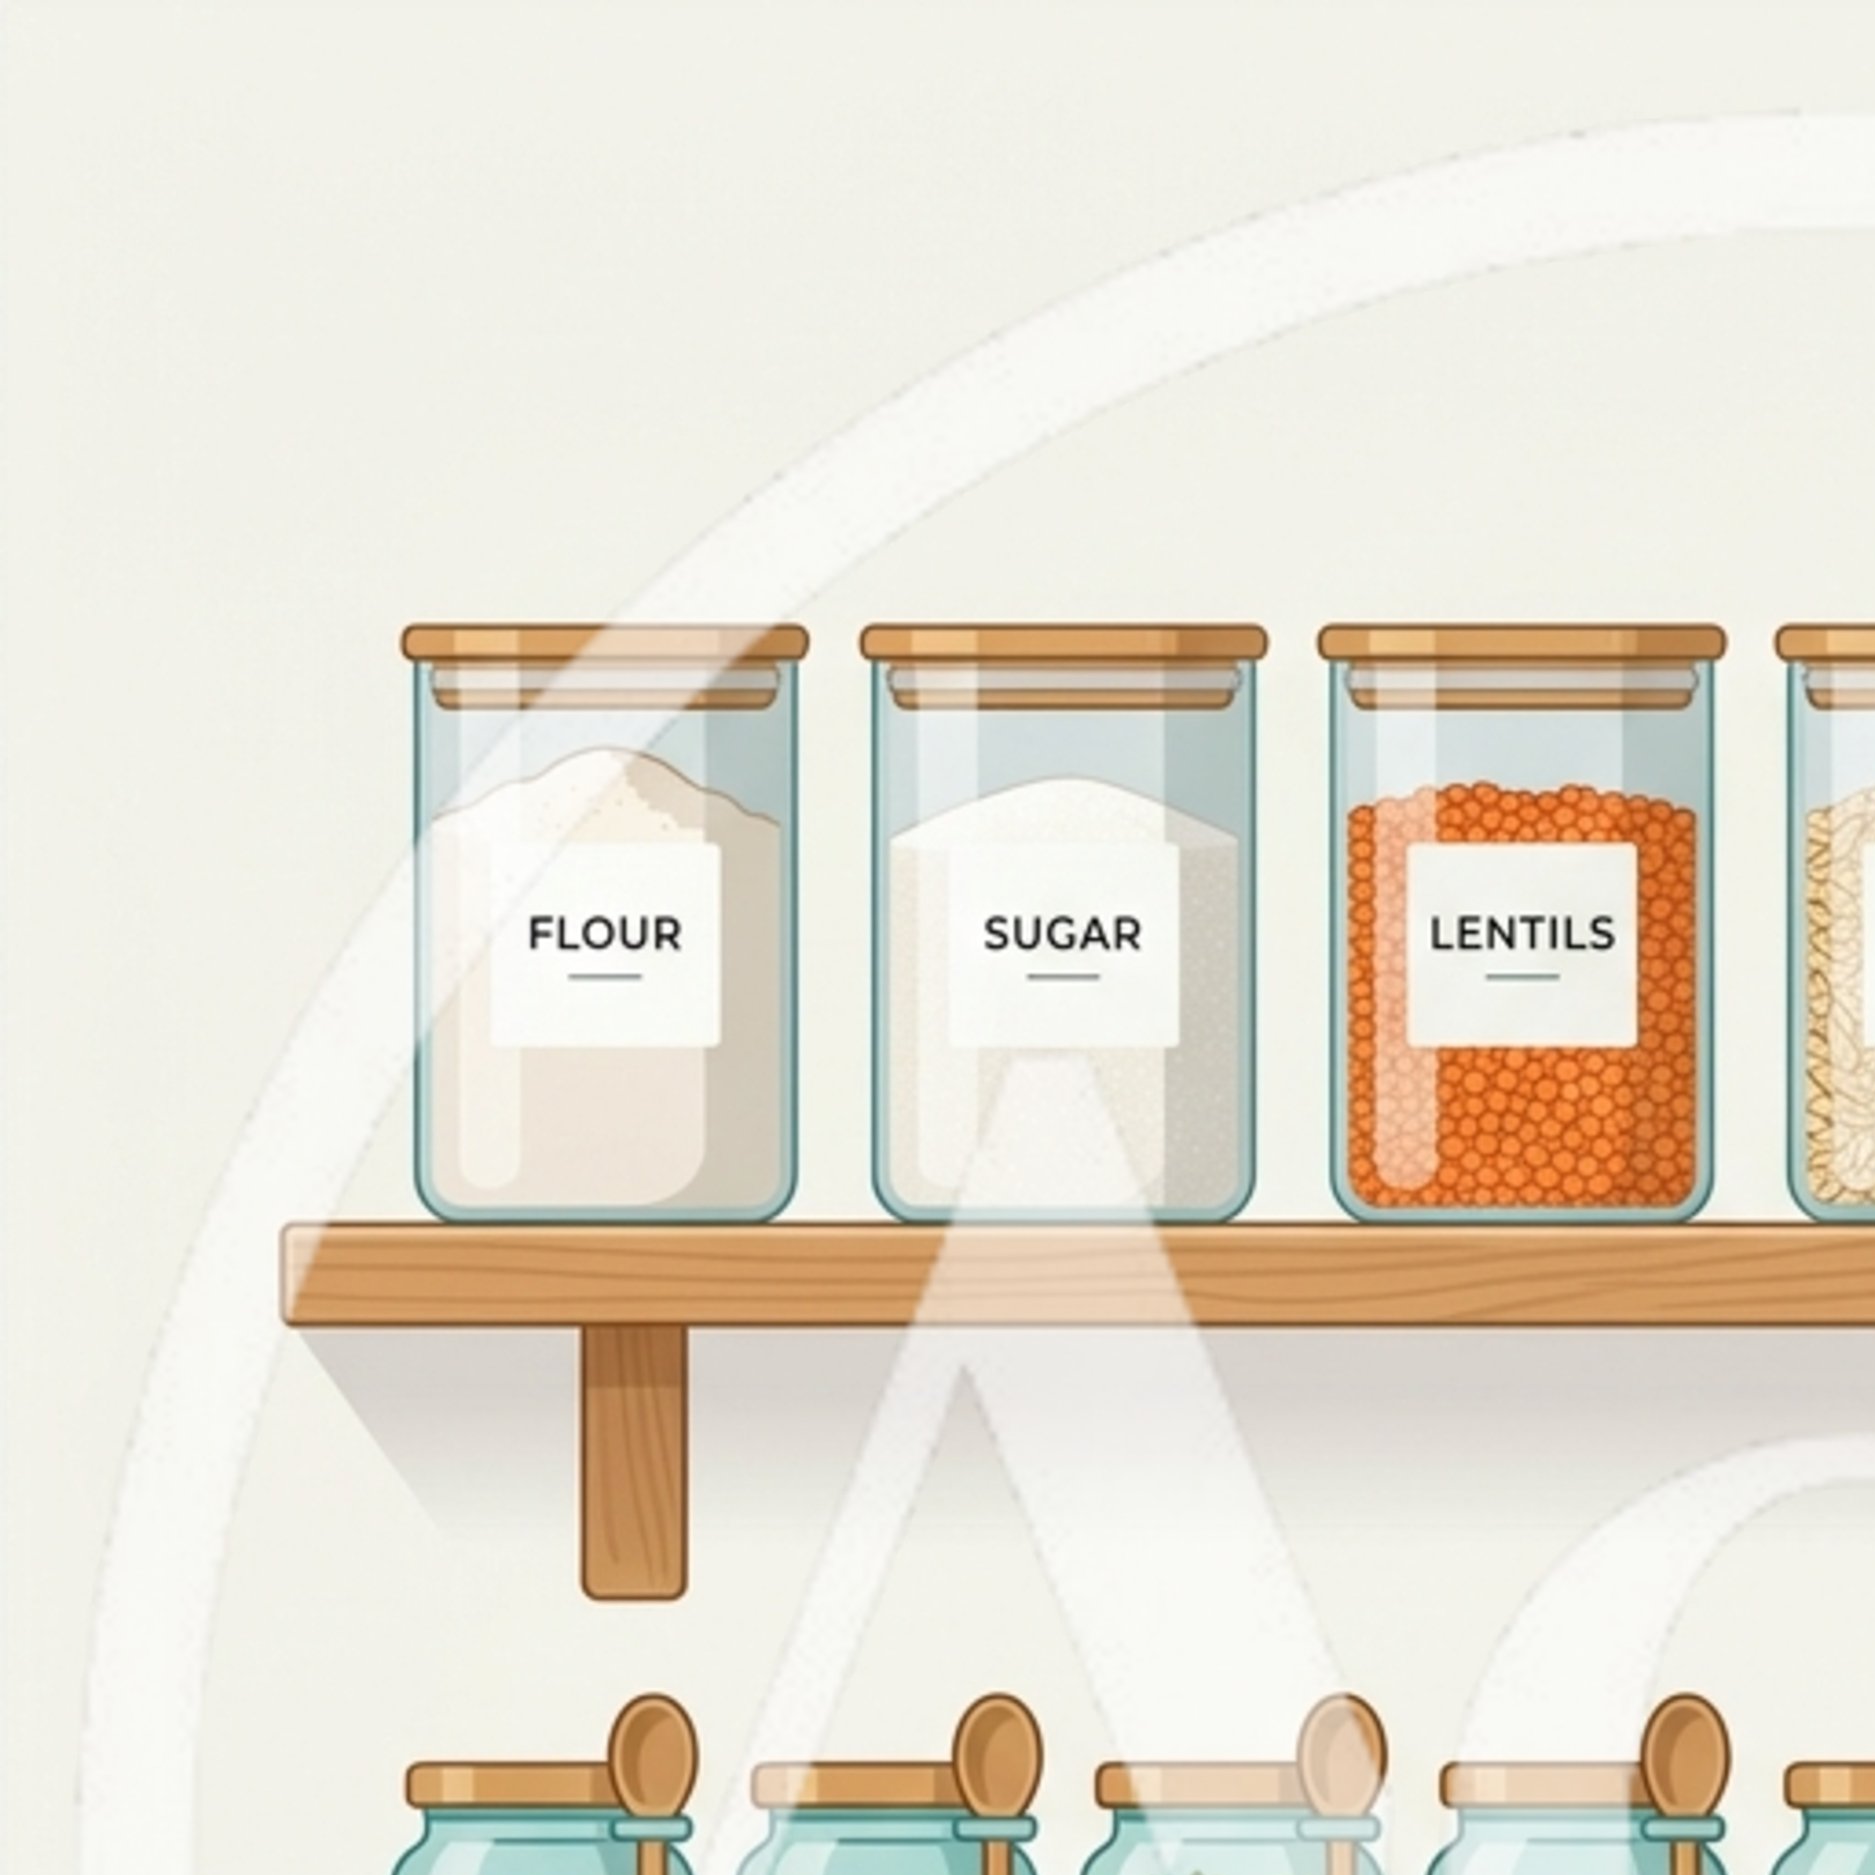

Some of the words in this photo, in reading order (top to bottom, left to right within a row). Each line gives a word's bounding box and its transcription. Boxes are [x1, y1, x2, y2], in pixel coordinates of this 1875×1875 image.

[529, 914, 683, 952] FLOUR
[984, 914, 1142, 952] SUGAR
[1430, 914, 1616, 952] LENTILS
